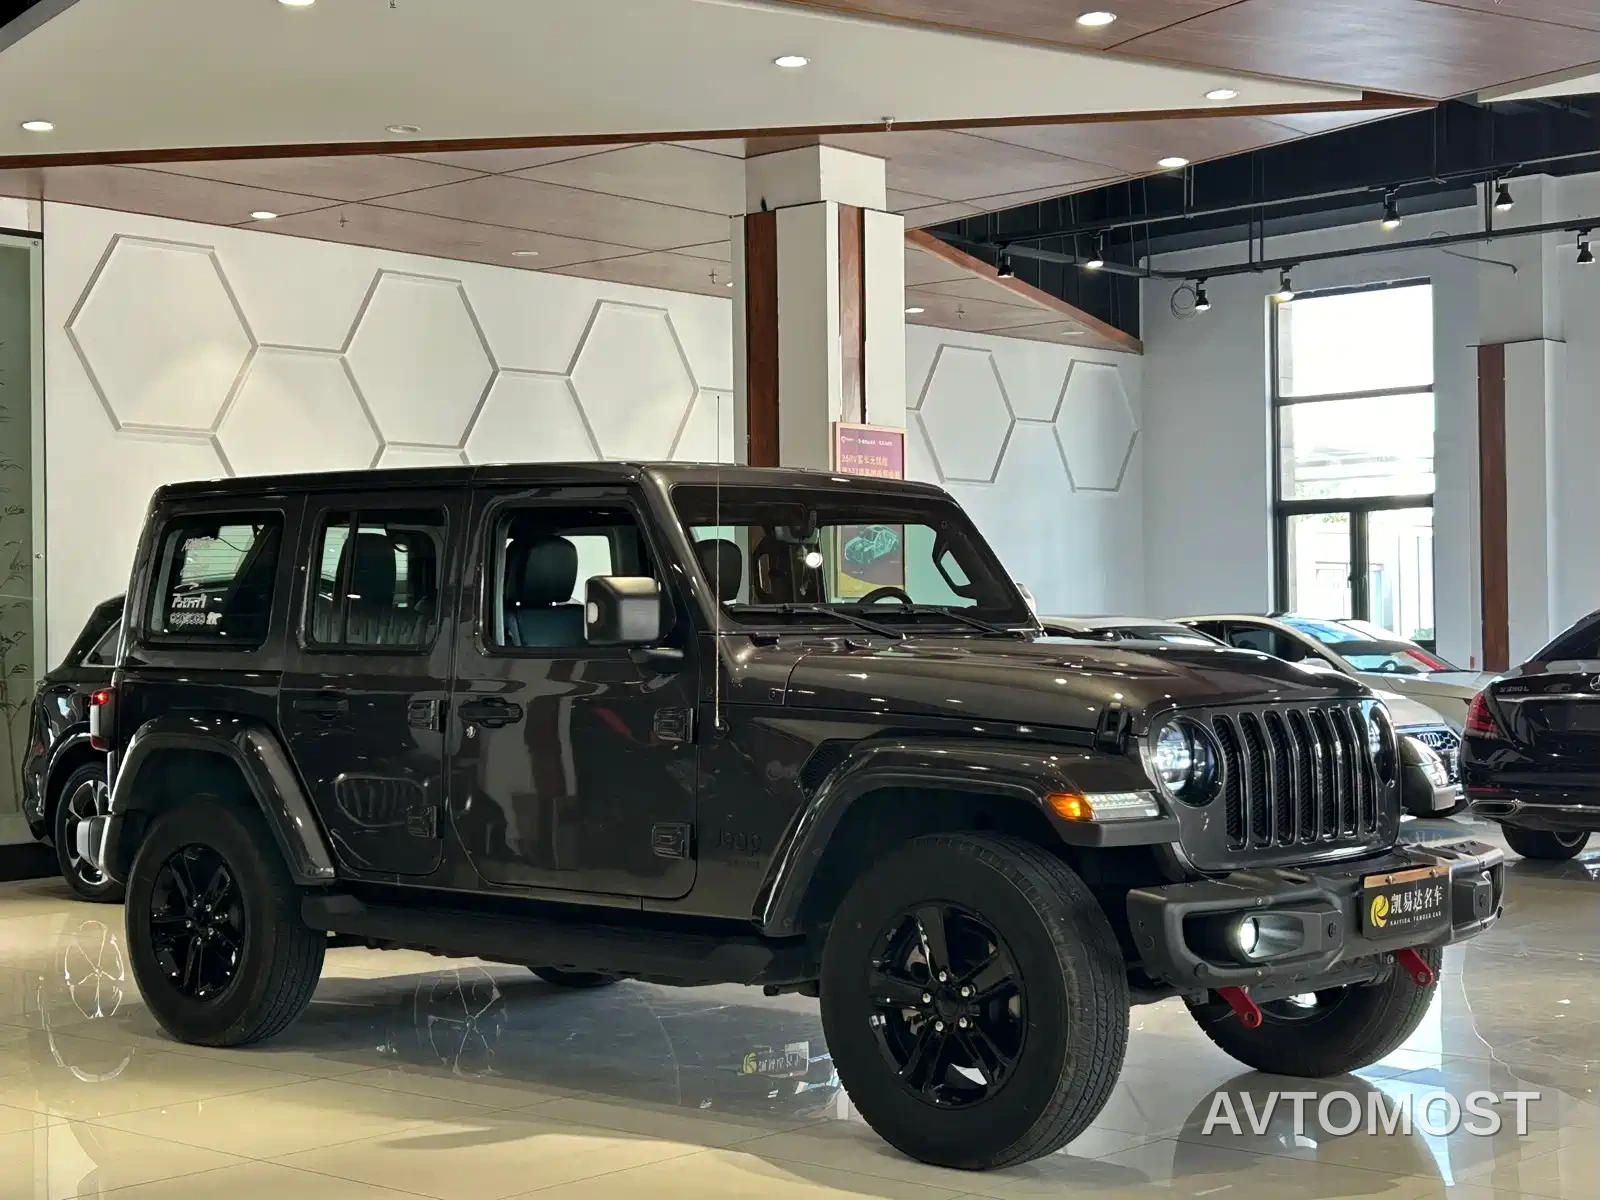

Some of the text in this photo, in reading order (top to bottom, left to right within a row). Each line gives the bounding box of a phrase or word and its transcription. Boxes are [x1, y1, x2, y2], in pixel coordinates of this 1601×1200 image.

[1391, 885, 1443, 914] 凯易达名车
